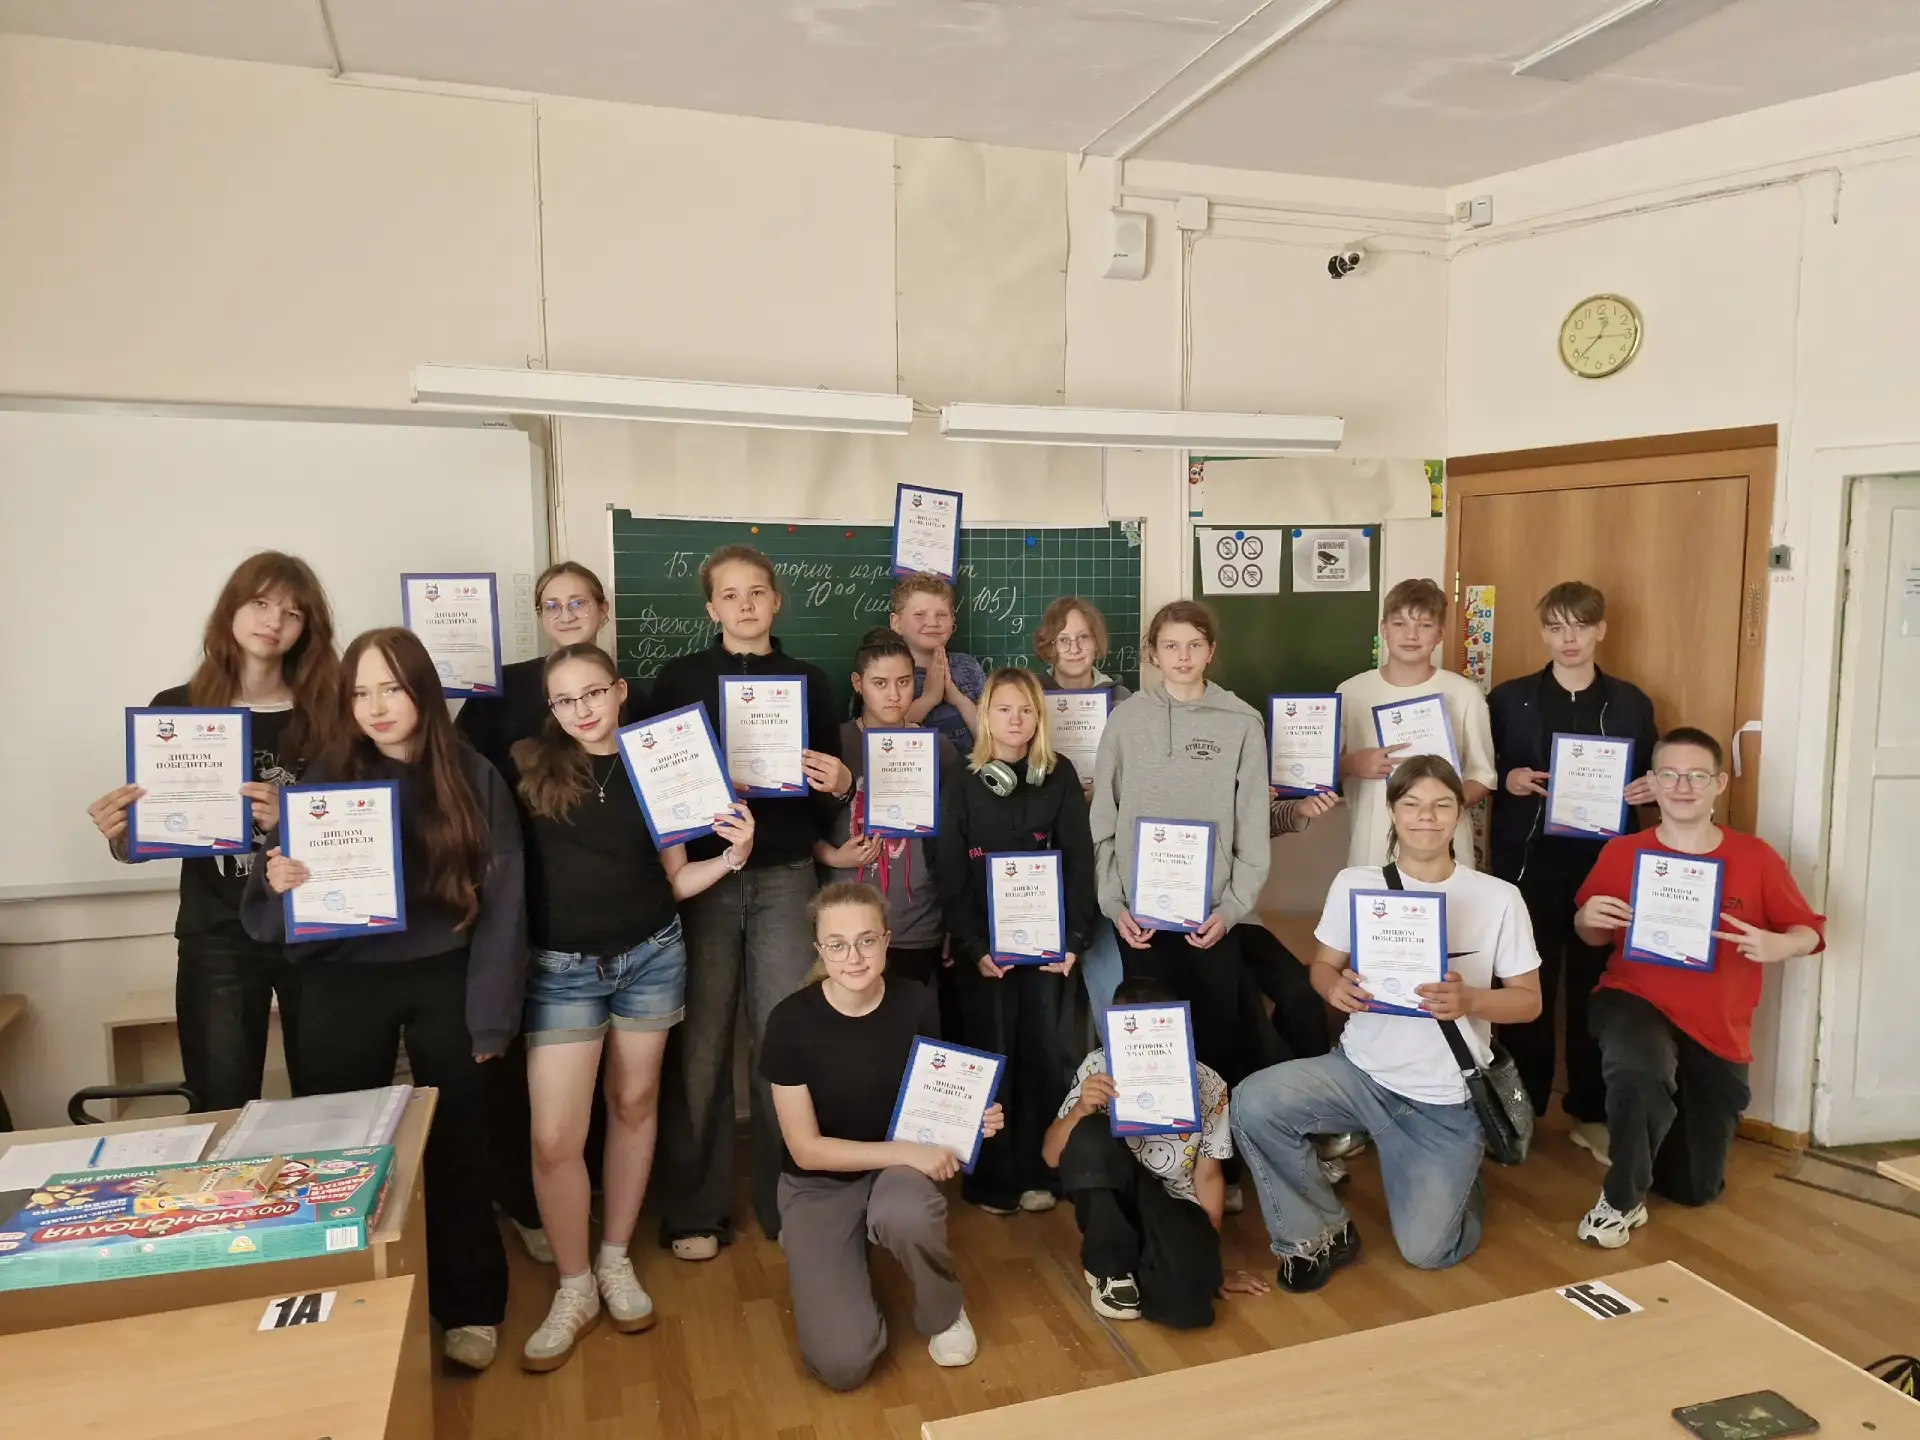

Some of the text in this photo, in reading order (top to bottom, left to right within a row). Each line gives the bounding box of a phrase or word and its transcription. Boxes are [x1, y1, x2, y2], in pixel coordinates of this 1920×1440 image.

[1596, 304, 1607, 315] 12
[1612, 305, 1617, 316] 1
[1620, 313, 1629, 325] 2
[1574, 320, 1584, 330] 10
[1624, 328, 1632, 339] 3
[1572, 348, 1580, 358] 8
[1619, 344, 1626, 353] 4
[1582, 356, 1590, 367] 7
[1608, 353, 1616, 365] 5
[1594, 361, 1603, 370] 6
[1479, 609, 1492, 619] 10
[1482, 631, 1492, 644] 8
[1469, 656, 1477, 668] 7
[1185, 743, 1221, 754] ATHLETICS
[169, 753, 212, 762] ДИПЛОМ
[156, 761, 223, 770] ПОБЕДИТЕЛЯ
[321, 829, 364, 839] ДИПЛОМ
[309, 837, 375, 848] ПОБЕДИТЕЛЯ
[61, 1176, 93, 1185] ИГРА
[41, 1203, 295, 1239] 100% МОНОПОЛИЯ
